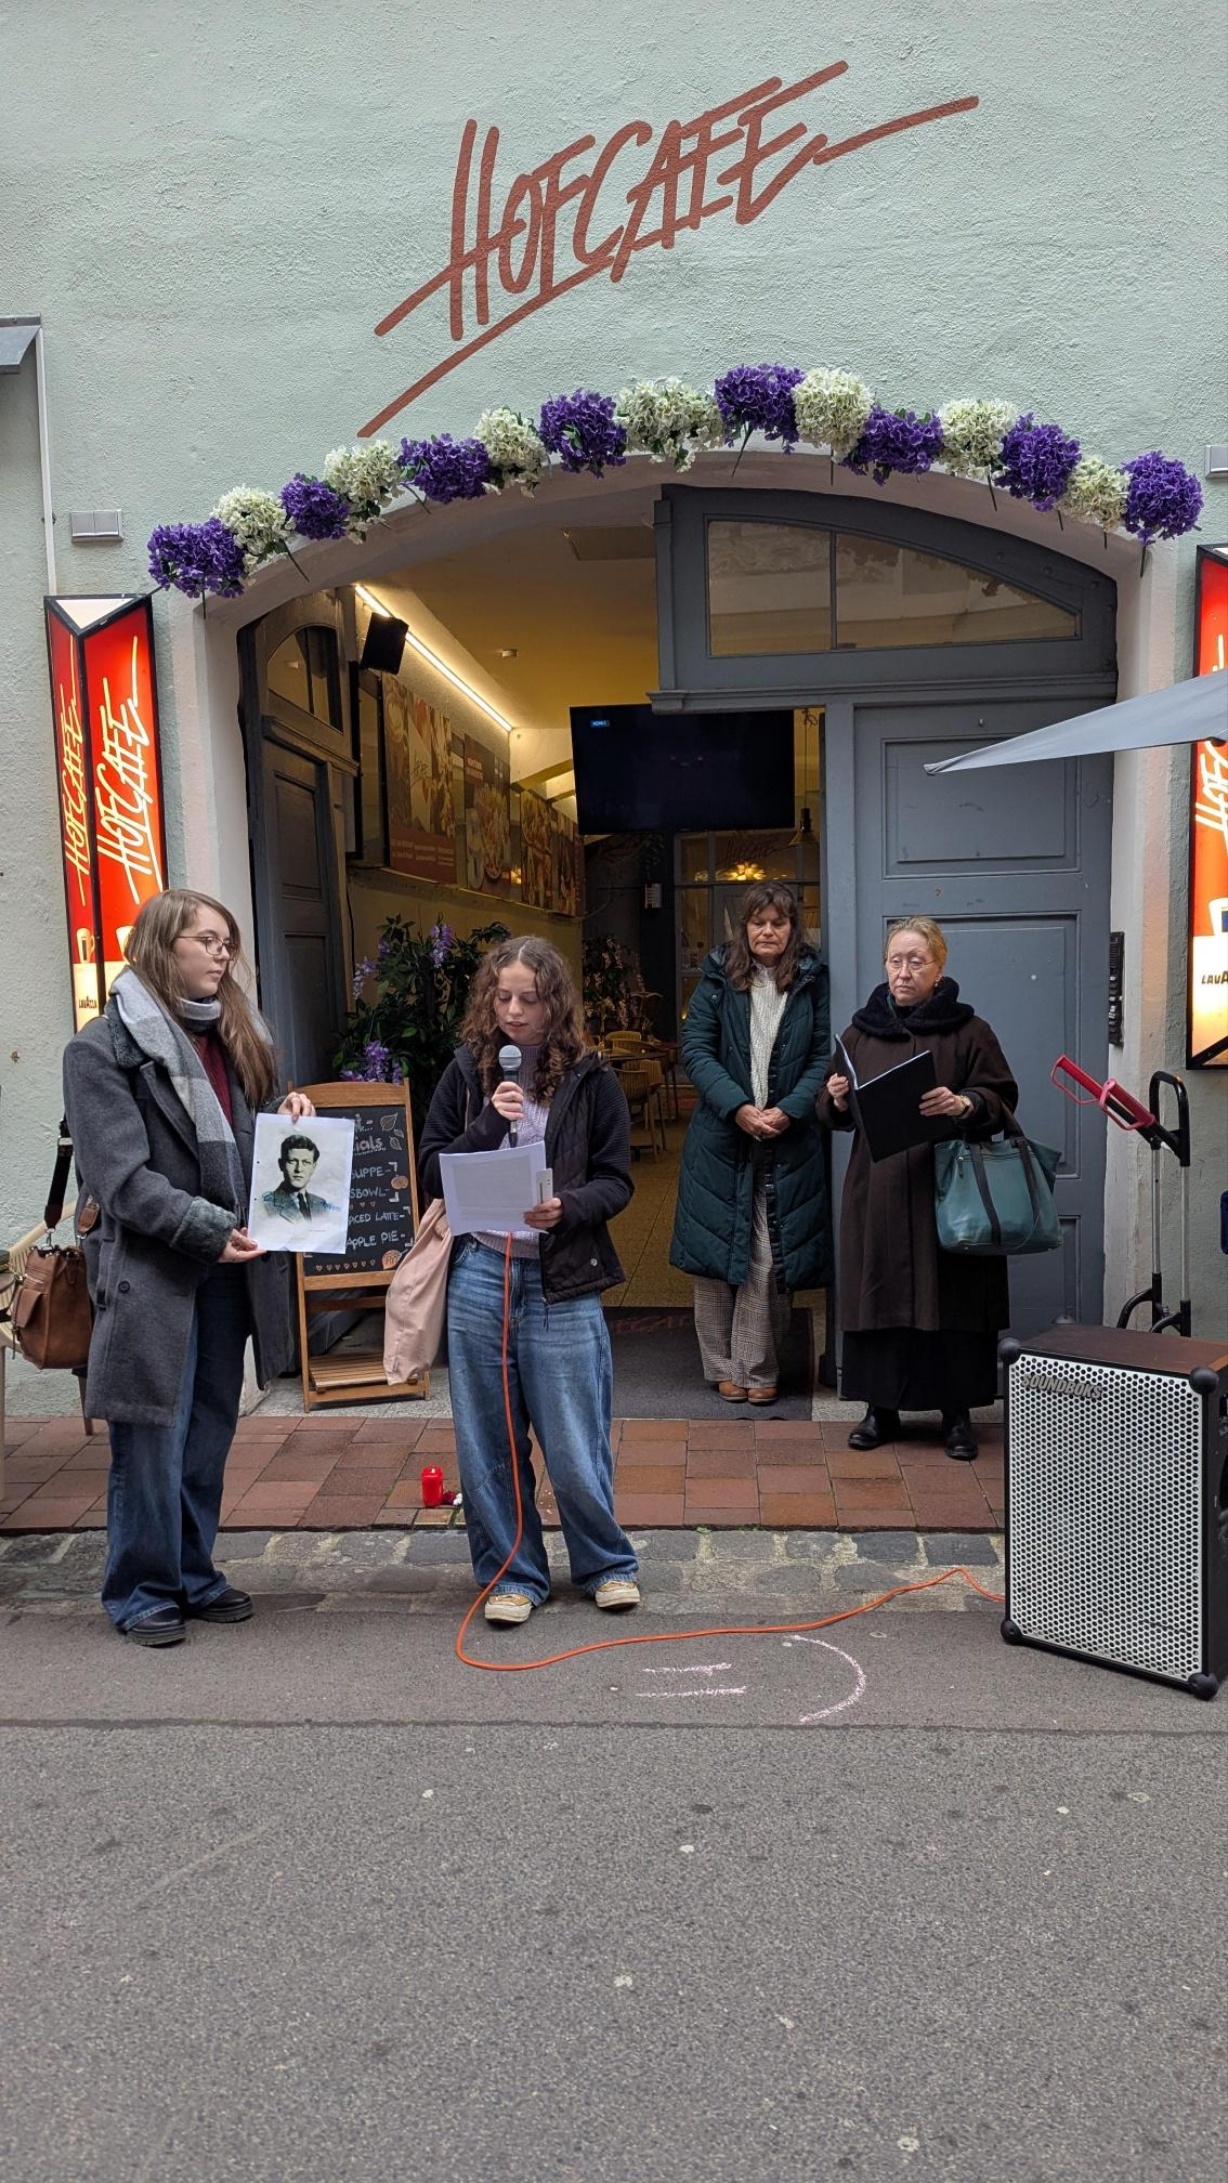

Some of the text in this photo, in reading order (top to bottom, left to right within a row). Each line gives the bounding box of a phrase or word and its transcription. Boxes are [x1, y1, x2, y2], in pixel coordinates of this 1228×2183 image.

[60, 634, 91, 907] HOFCAFE
[95, 636, 163, 904] HOFCAFE
[353, 1135, 383, 1152] ials
[1021, 1373, 1103, 1399] SOUNDBOKS
